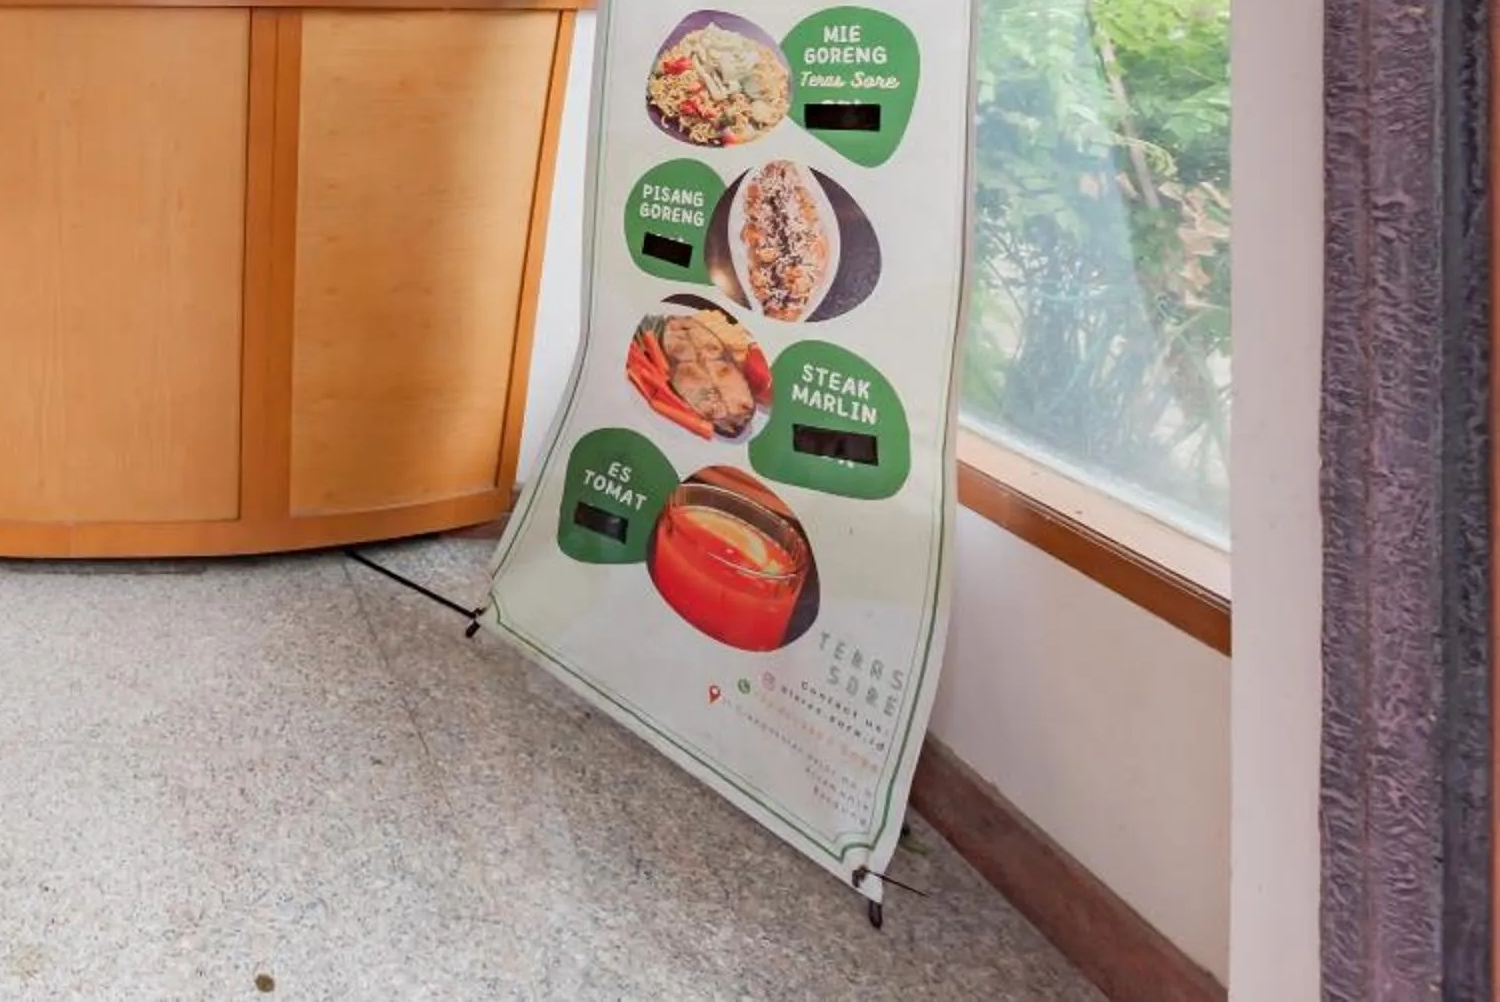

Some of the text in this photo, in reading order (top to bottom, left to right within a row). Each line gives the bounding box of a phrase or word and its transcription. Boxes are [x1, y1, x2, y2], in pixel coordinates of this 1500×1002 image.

[823, 25, 862, 44] MIE
[803, 46, 888, 65] GORENG
[799, 71, 901, 90] Teras Sore
[642, 183, 704, 207] PISANG
[639, 203, 705, 227] GORENG
[801, 363, 872, 399] STEAK
[791, 384, 877, 425] MARLIN
[607, 461, 632, 483] ES
[583, 469, 648, 511] TOMAT
[819, 631, 904, 691] TERAS
